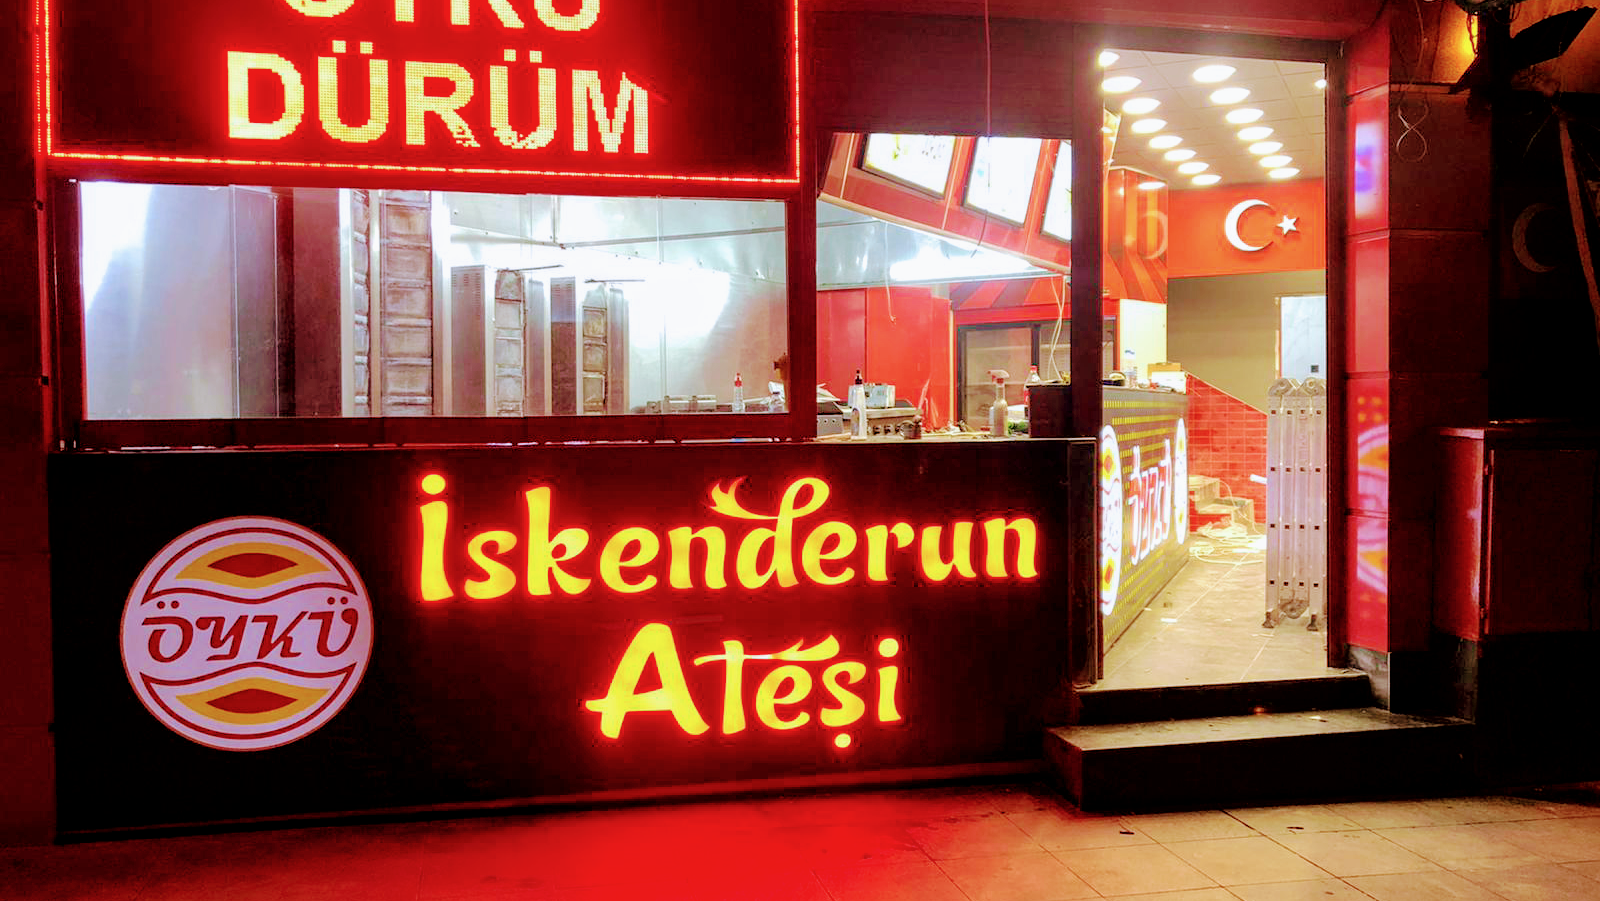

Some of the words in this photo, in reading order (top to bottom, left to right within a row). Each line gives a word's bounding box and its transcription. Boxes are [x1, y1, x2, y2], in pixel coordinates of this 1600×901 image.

[227, 40, 649, 154] DÜRÜM
[419, 474, 1039, 602] İskenderun
[141, 596, 359, 663] ÖYKÜ
[585, 622, 904, 749] Ateşi
